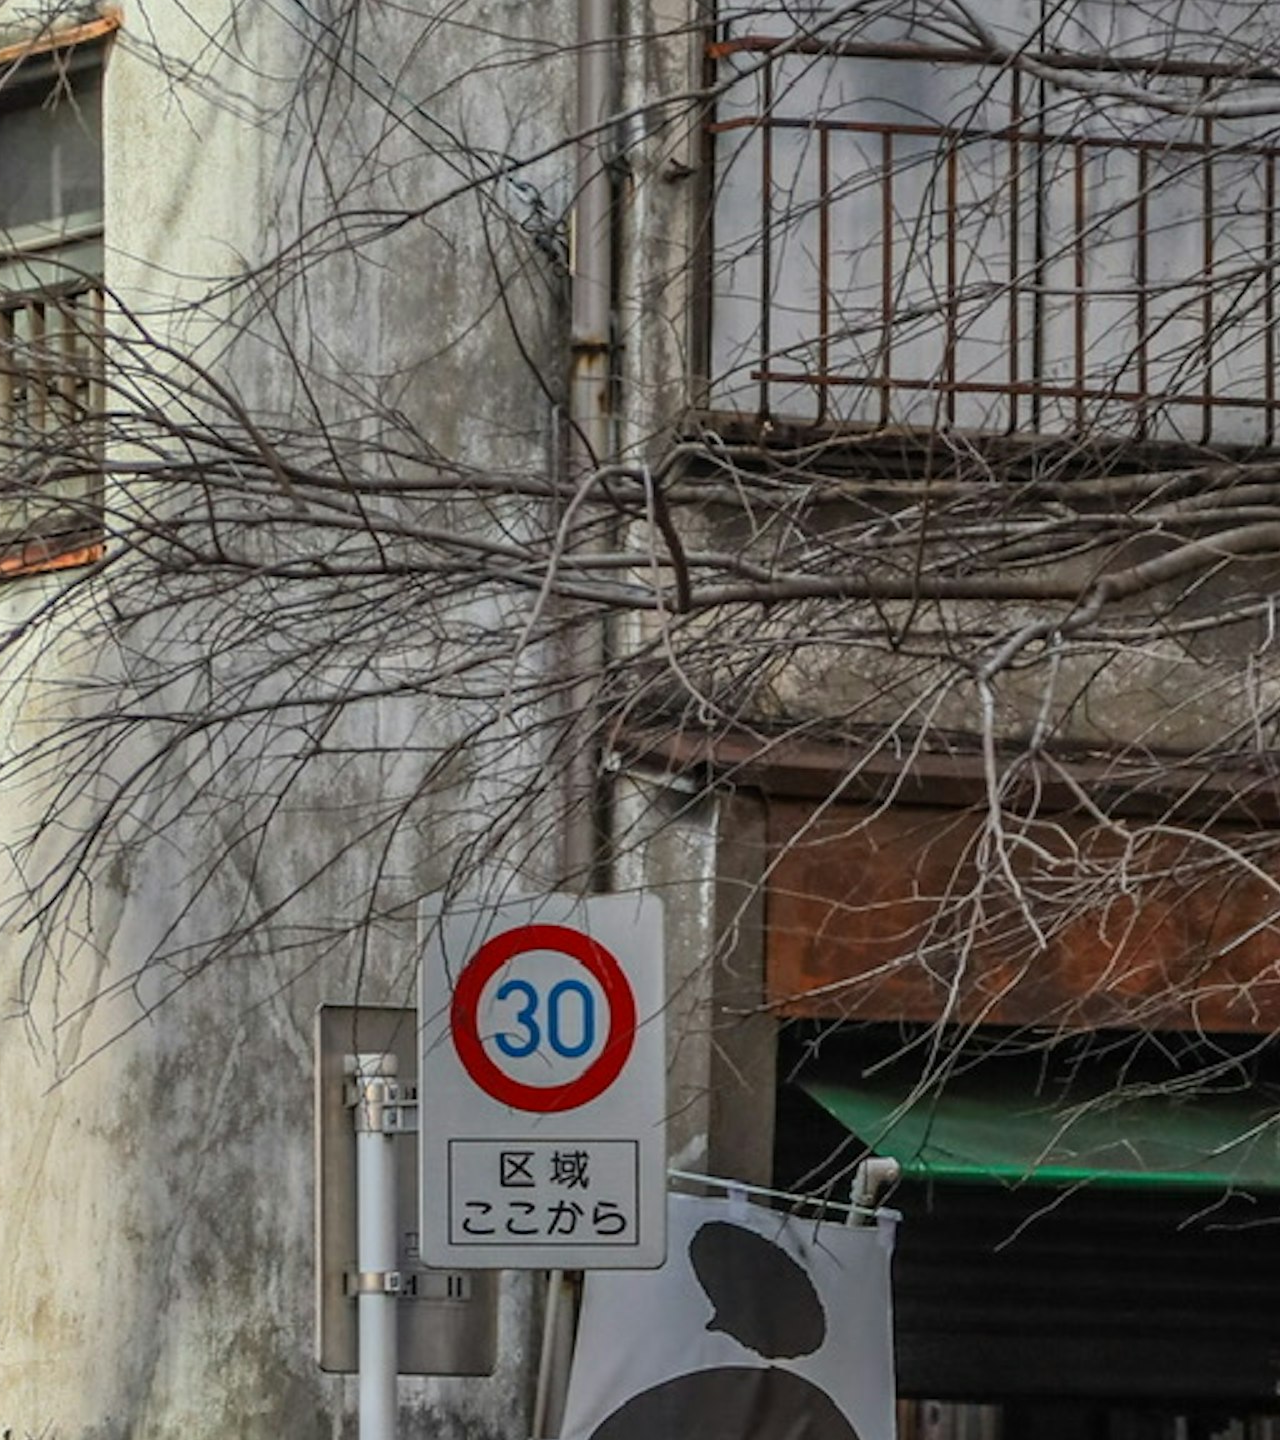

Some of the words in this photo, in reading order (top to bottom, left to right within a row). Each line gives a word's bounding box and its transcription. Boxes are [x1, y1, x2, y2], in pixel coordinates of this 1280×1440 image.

[493, 978, 596, 1060] 30
[499, 1149, 591, 1191] 区域
[461, 1199, 629, 1238] ここから
